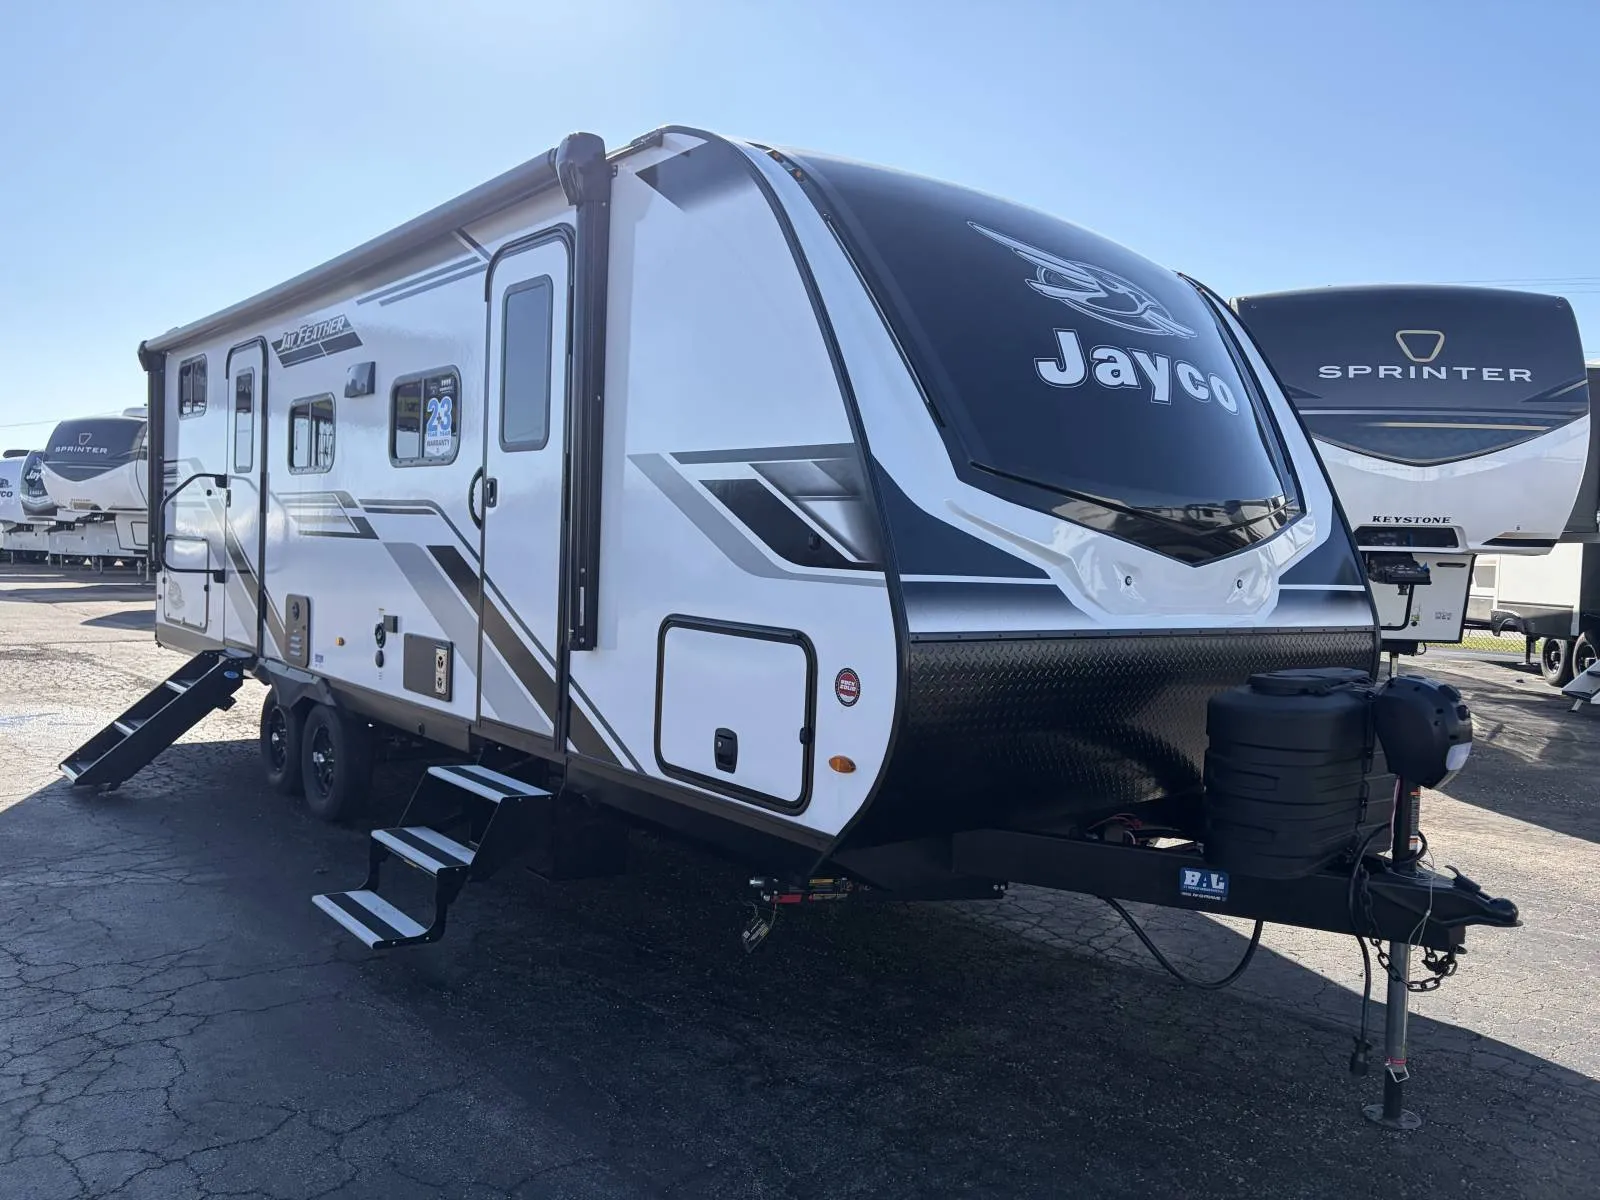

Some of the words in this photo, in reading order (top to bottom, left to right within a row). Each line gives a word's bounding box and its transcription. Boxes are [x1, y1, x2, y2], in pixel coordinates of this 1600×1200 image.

[297, 315, 346, 346] FEATHER
[1034, 327, 1240, 416] Jayco
[1318, 365, 1533, 382] SPRINTER
[55, 446, 108, 455] SPRINTER
[1372, 515, 1452, 524] KEYSTONE
